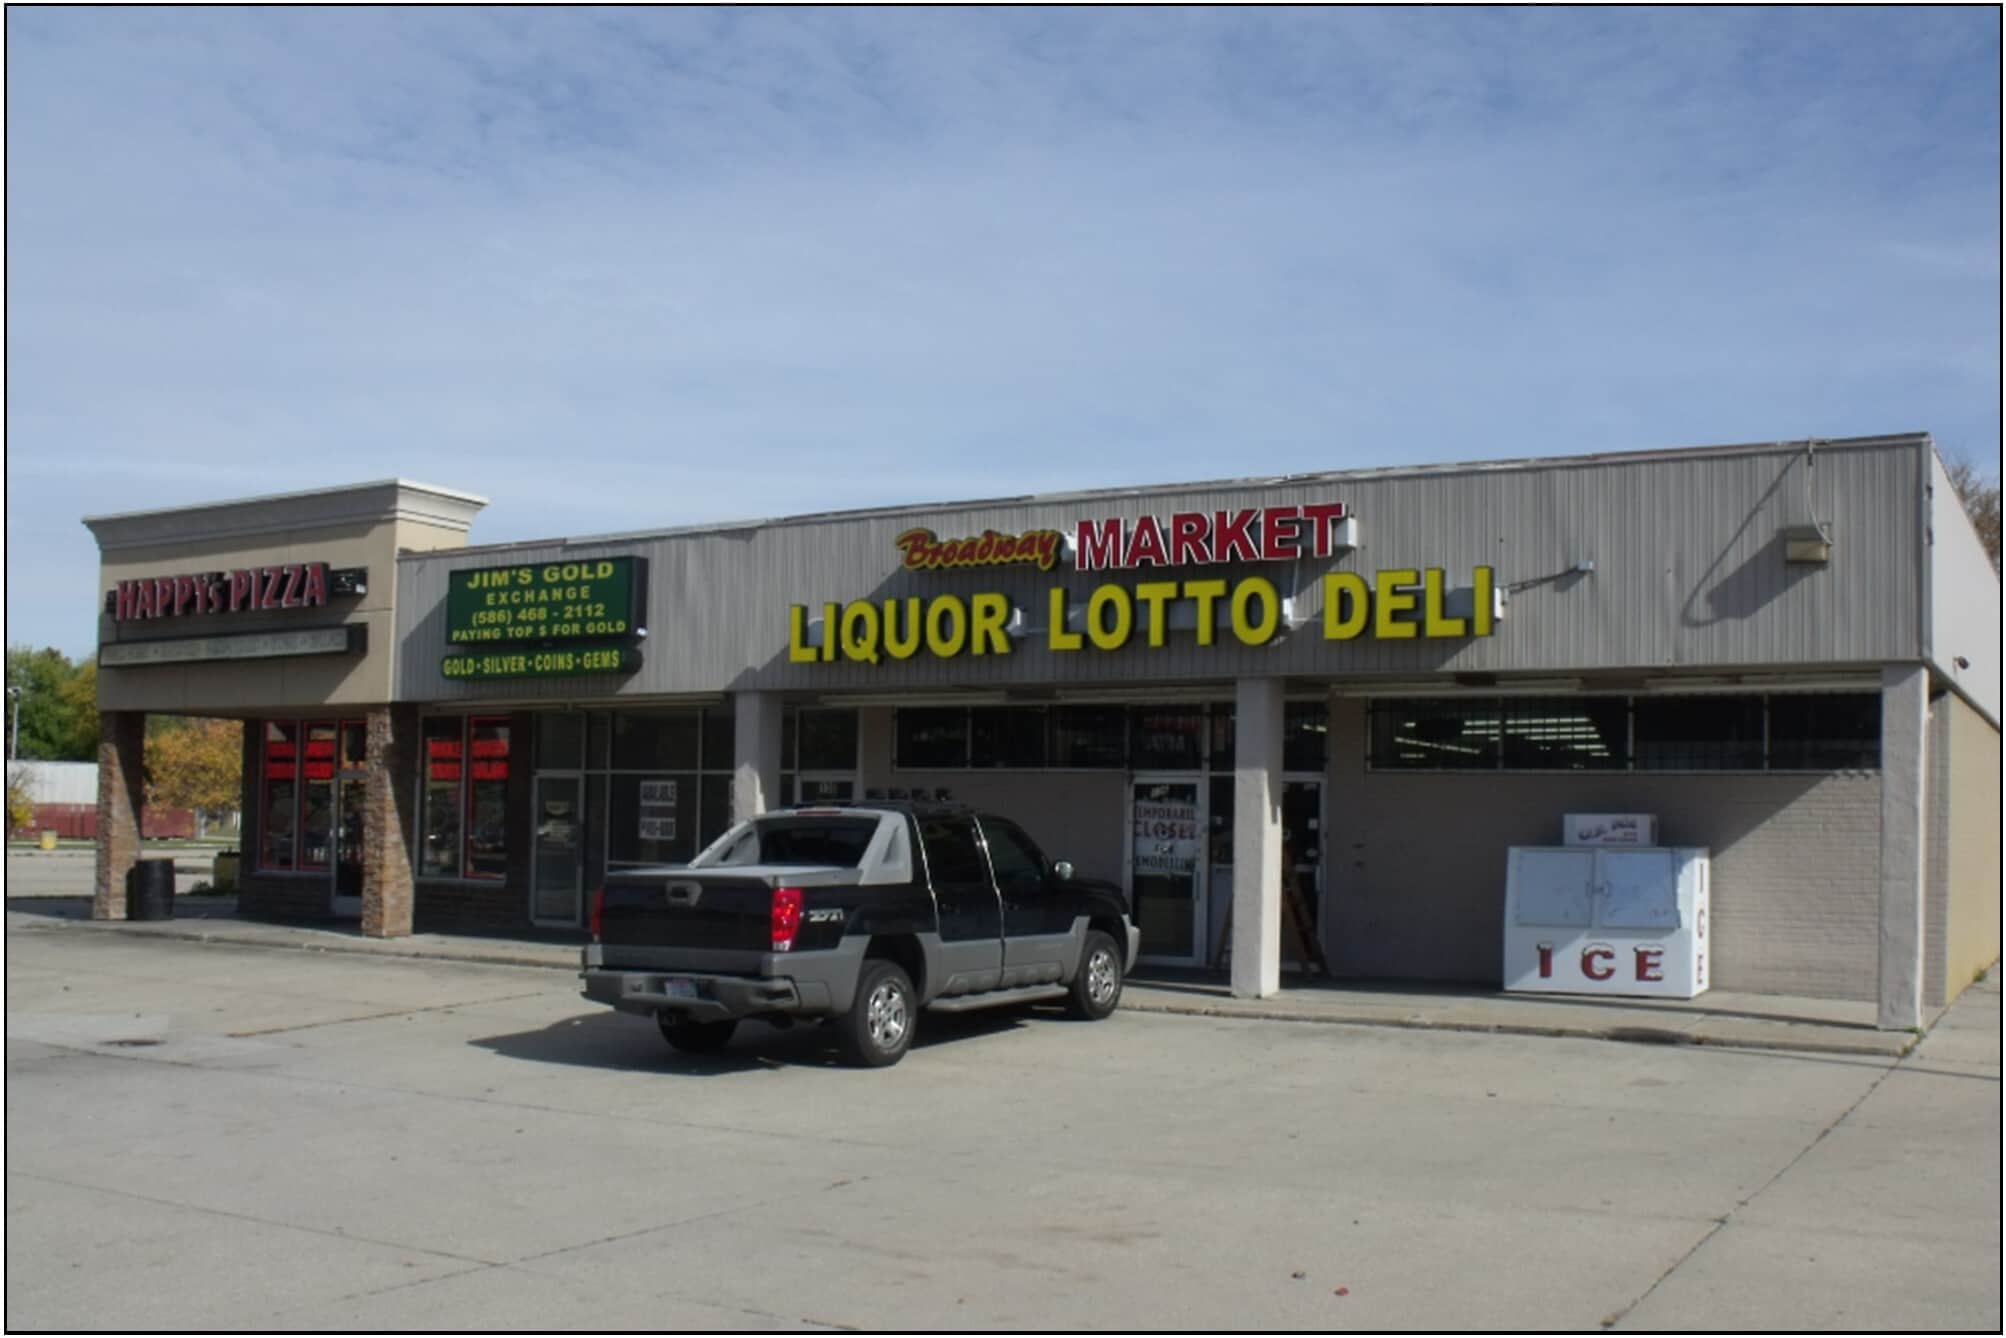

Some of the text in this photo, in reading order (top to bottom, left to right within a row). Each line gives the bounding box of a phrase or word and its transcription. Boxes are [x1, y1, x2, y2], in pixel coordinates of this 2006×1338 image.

[896, 527, 1058, 570] Broadway
[1074, 503, 1346, 571] MARKET
[230, 562, 326, 611] PIZZA
[466, 561, 614, 589] JIM'S GOLD
[486, 585, 591, 606] EXCHANGE
[452, 620, 627, 641] PAYING TOP $ FOR GOLD
[472, 606, 512, 627] (586)
[517, 606, 548, 622] 468
[563, 603, 606, 619] 2112
[788, 566, 1492, 665] LIQUOR LOTTO DELI
[443, 650, 620, 676] GOLD SILVER COINS GEMS
[1537, 942, 1664, 982] ICE
